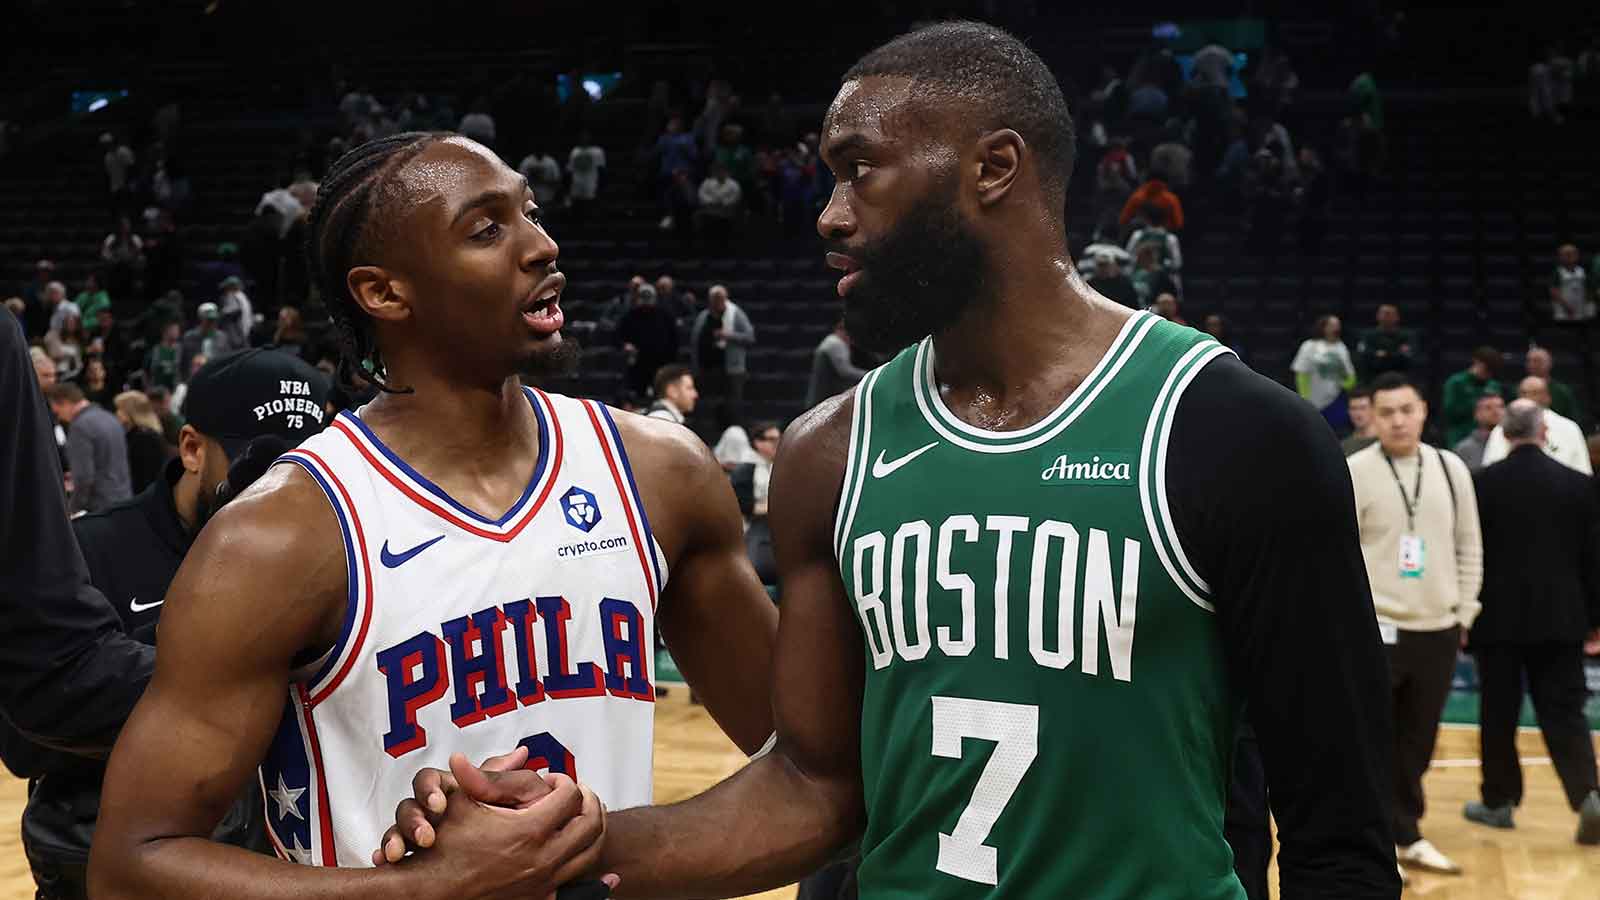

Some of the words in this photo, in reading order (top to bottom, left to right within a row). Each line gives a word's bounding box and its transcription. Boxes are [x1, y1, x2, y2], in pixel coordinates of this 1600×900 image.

[279, 380, 311, 396] NBA
[286, 414, 304, 429] 75
[1041, 454, 1131, 480] Amica
[557, 536, 627, 557] crypto.com
[853, 514, 1141, 682] BOSTON
[376, 595, 656, 760] PHILA
[930, 695, 1040, 886] 7
